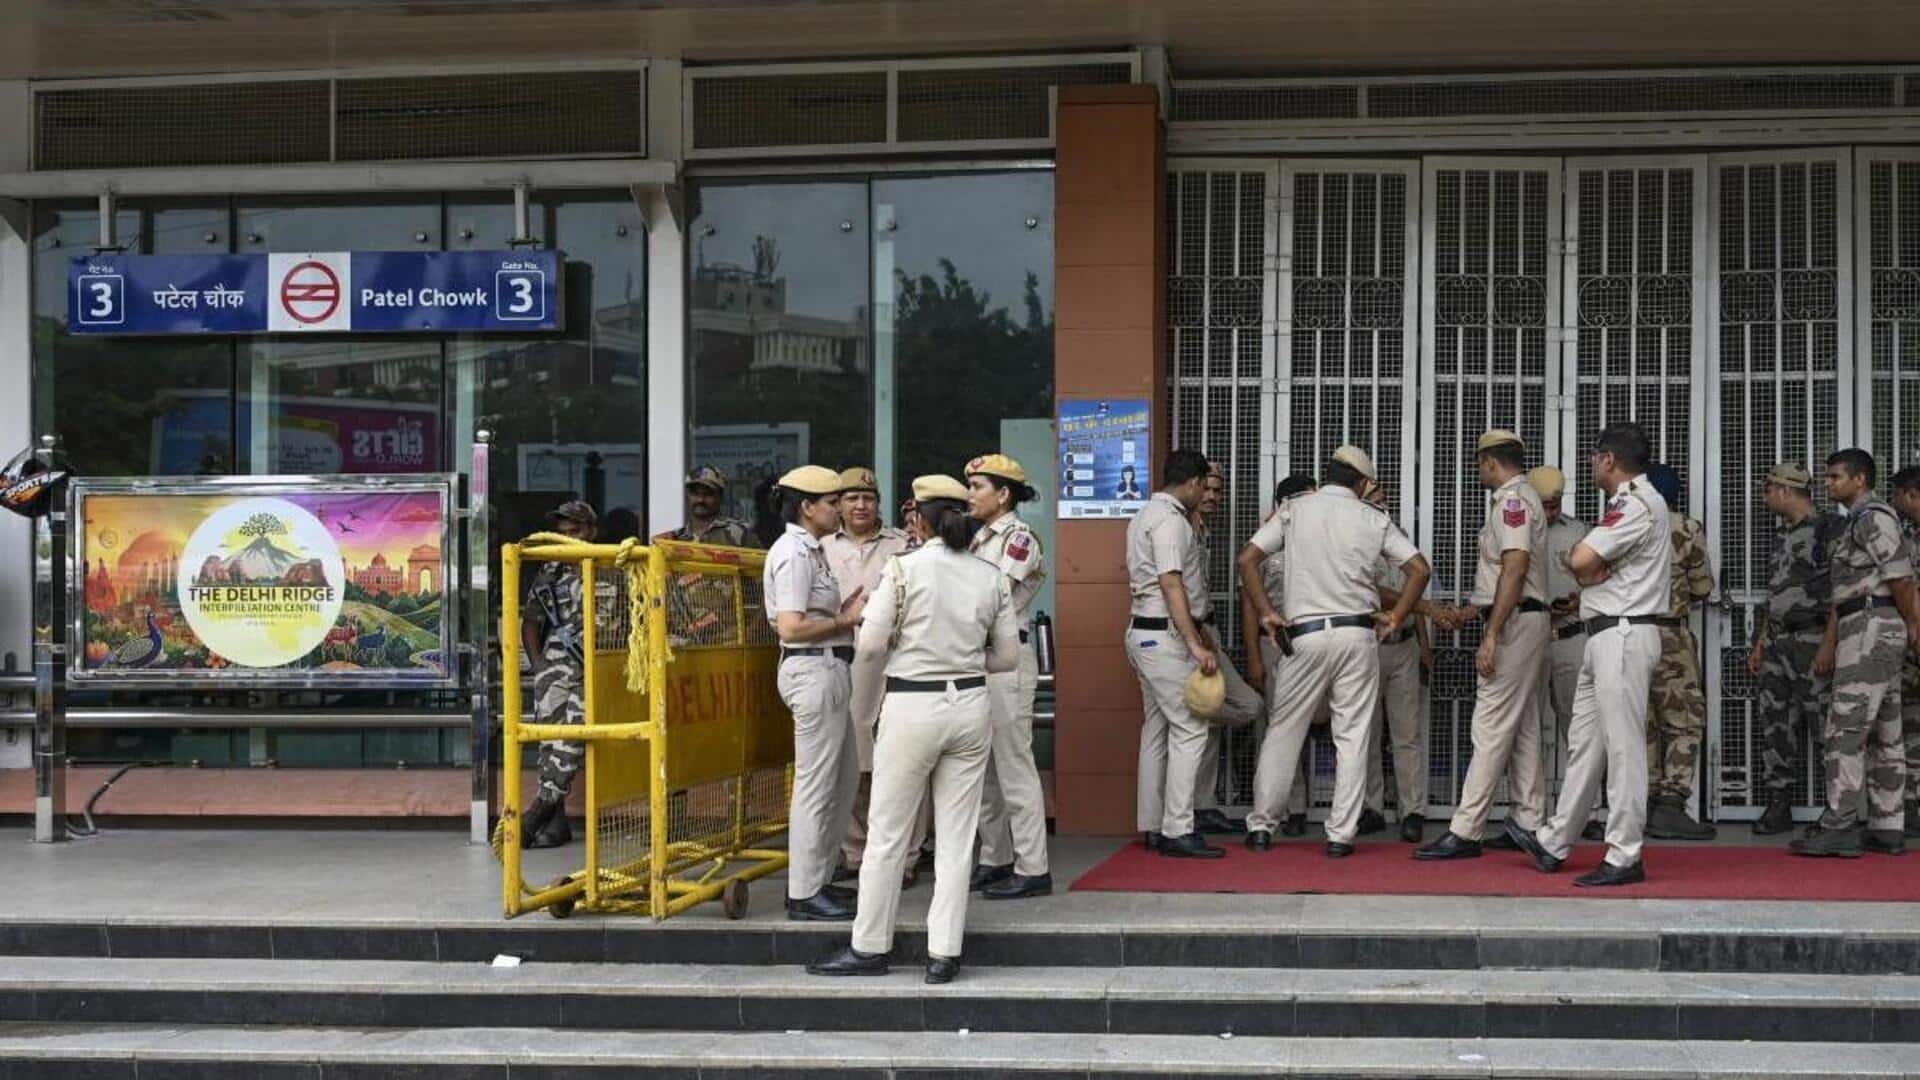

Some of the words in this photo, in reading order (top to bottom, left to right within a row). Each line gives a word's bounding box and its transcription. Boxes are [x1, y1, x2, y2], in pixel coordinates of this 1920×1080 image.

[502, 261, 522, 270] Gate
[90, 282, 113, 318] 3
[152, 284, 198, 309] पटेल
[203, 283, 245, 308] चौक
[360, 288, 413, 307] Patel
[418, 287, 488, 307] Chowk
[508, 277, 533, 313] 3
[189, 588, 221, 601] THE
[226, 588, 276, 601] DELHI
[282, 588, 335, 601] RIDGE
